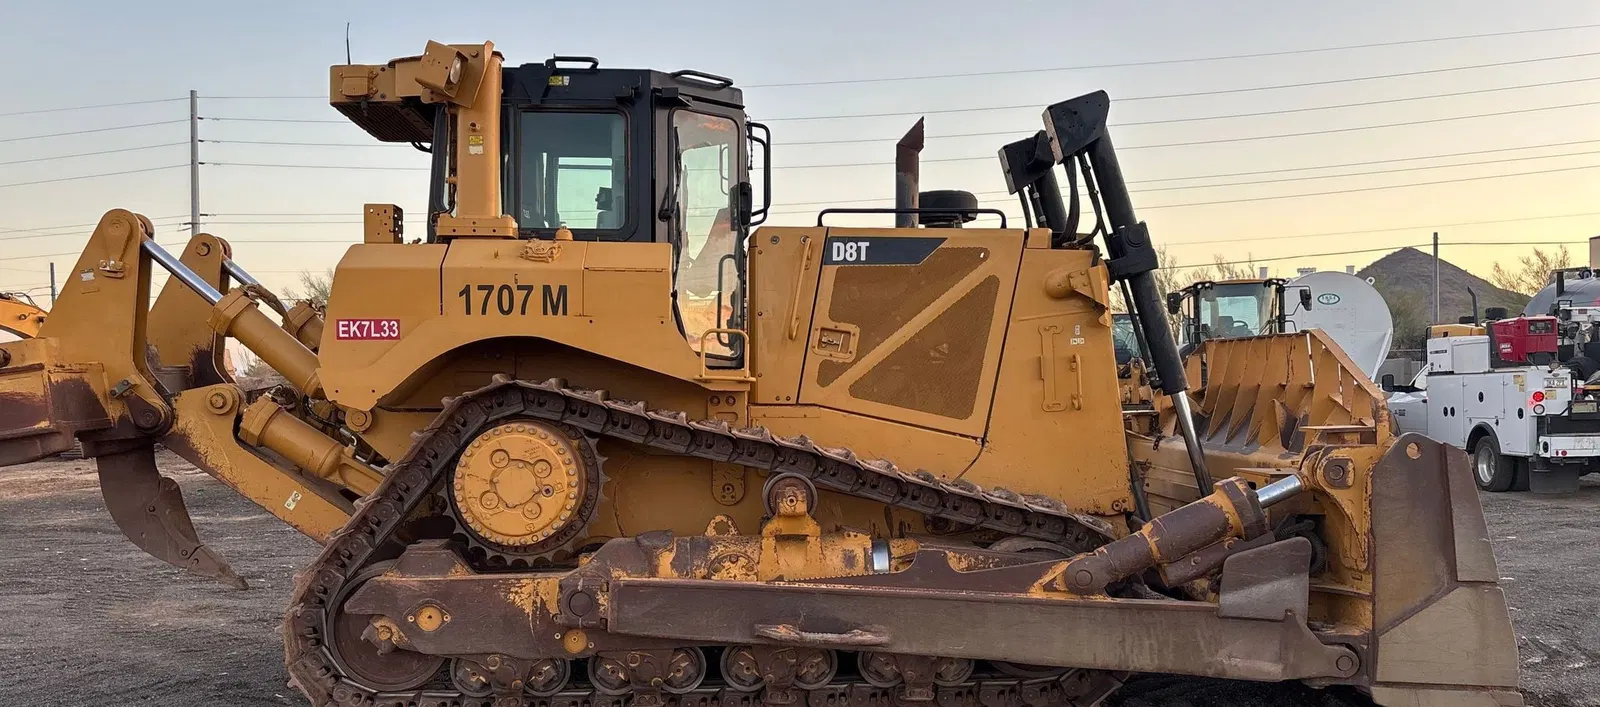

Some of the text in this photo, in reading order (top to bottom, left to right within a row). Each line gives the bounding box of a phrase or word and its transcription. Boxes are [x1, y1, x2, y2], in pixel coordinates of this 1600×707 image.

[832, 241, 870, 262] D8T
[458, 284, 568, 316] 1707 M
[338, 320, 399, 338] EK7L33
